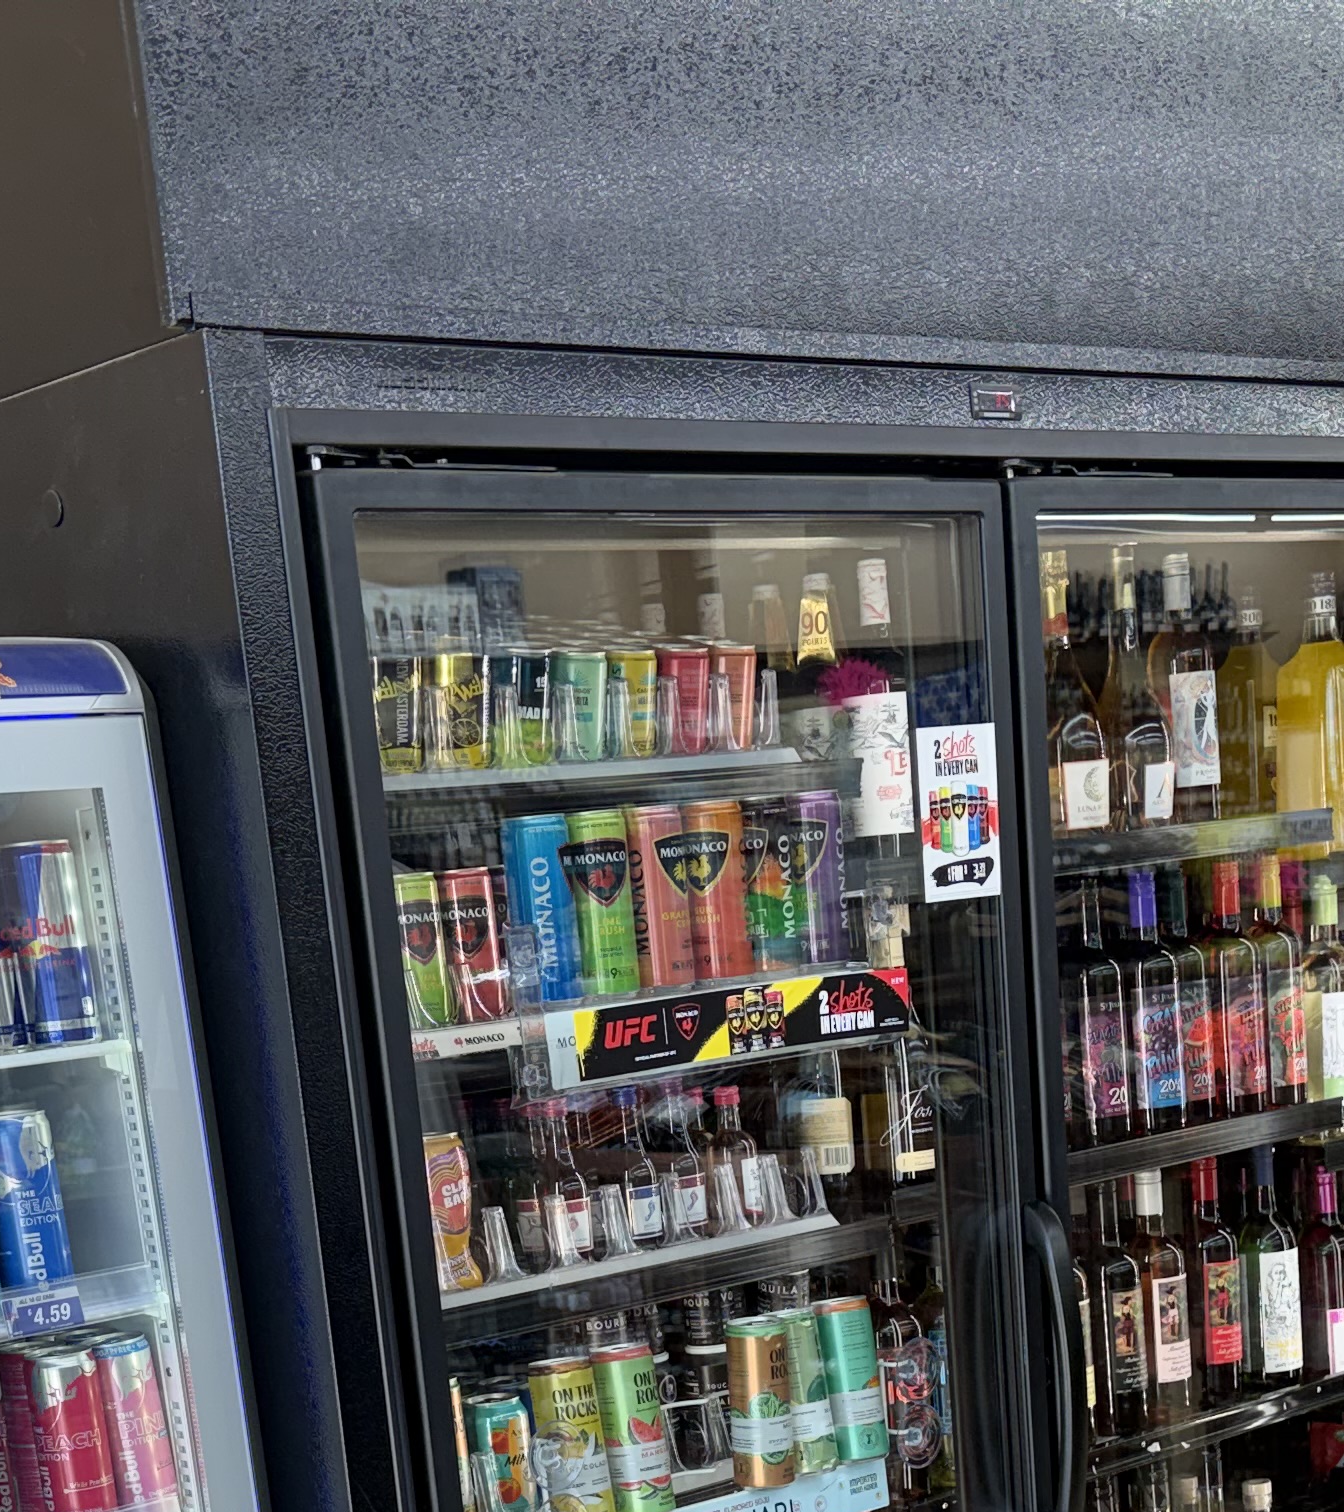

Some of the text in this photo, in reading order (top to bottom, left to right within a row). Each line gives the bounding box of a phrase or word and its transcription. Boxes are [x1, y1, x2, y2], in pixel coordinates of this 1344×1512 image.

[801, 610, 828, 637] 90
[934, 739, 942, 760] 2
[935, 758, 979, 777] IN EVERY CAN
[574, 850, 626, 865] MONACO
[777, 834, 796, 939] MONACO
[834, 827, 850, 929] MONACO
[529, 856, 561, 970] MONACO
[629, 850, 651, 956] MONACO
[36, 914, 76, 937] Bull
[818, 990, 830, 1014] 2
[603, 1013, 657, 1050] UFC
[830, 1012, 855, 1033] EVERY
[856, 1010, 876, 1029] CAN
[464, 1032, 505, 1046] MONACO
[16, 1189, 36, 1199] THE
[20, 1212, 61, 1228] EDITION
[22, 1231, 45, 1266] Bull
[633, 1371, 652, 1388] ON
[552, 1388, 573, 1405] ON
[554, 1400, 598, 1422] ROCKS
[36, 1428, 101, 1452] PEACH
